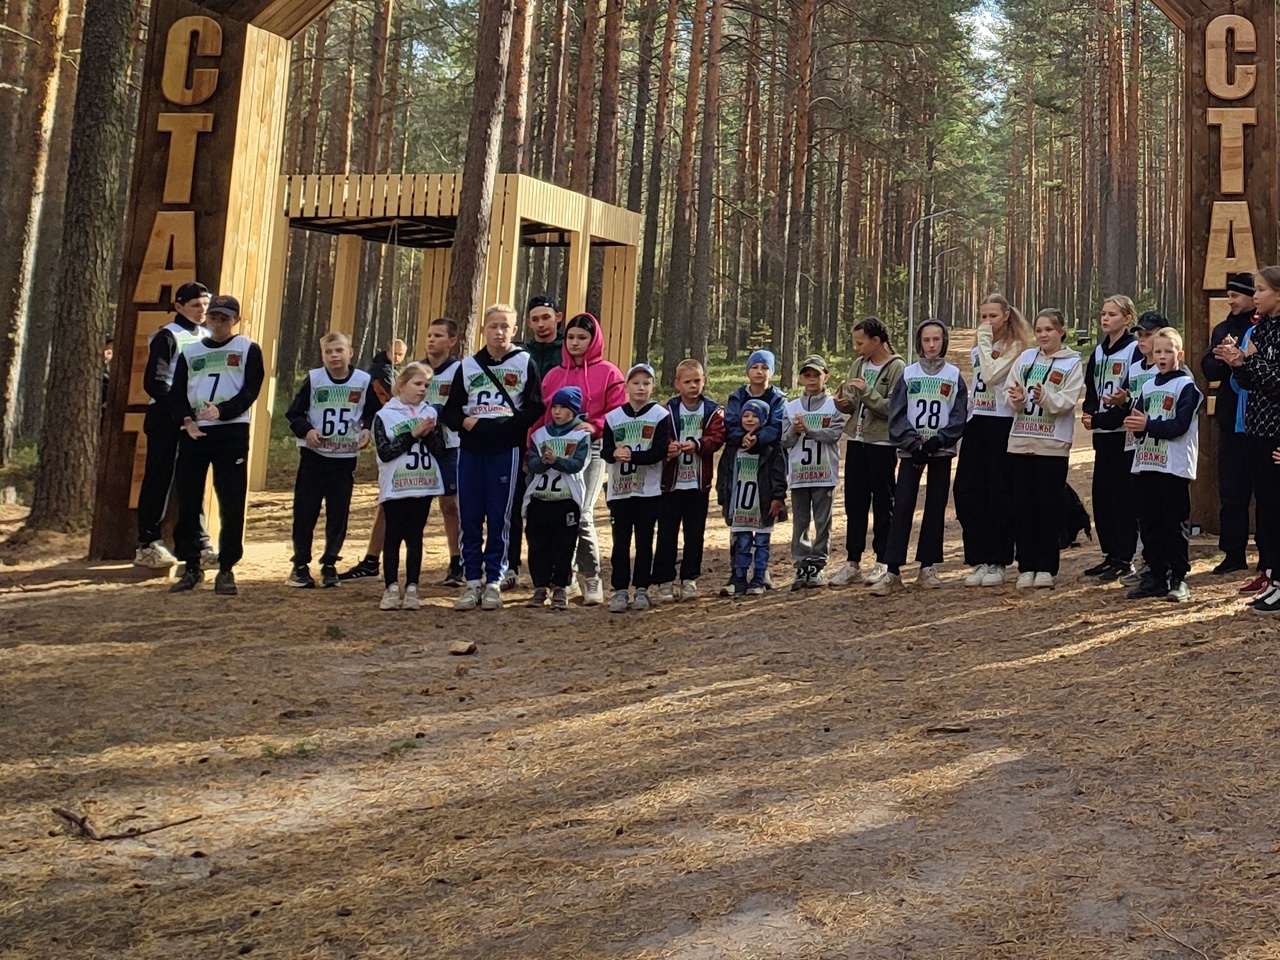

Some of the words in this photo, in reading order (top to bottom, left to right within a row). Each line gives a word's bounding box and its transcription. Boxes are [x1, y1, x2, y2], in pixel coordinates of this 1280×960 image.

[1203, 14, 1258, 415] СТА
[208, 373, 220, 402] 7
[915, 399, 941, 429] 28
[974, 400, 997, 408] АЖЬЕ
[322, 407, 351, 436] 65
[406, 440, 431, 470] 58
[735, 480, 757, 510] 10
